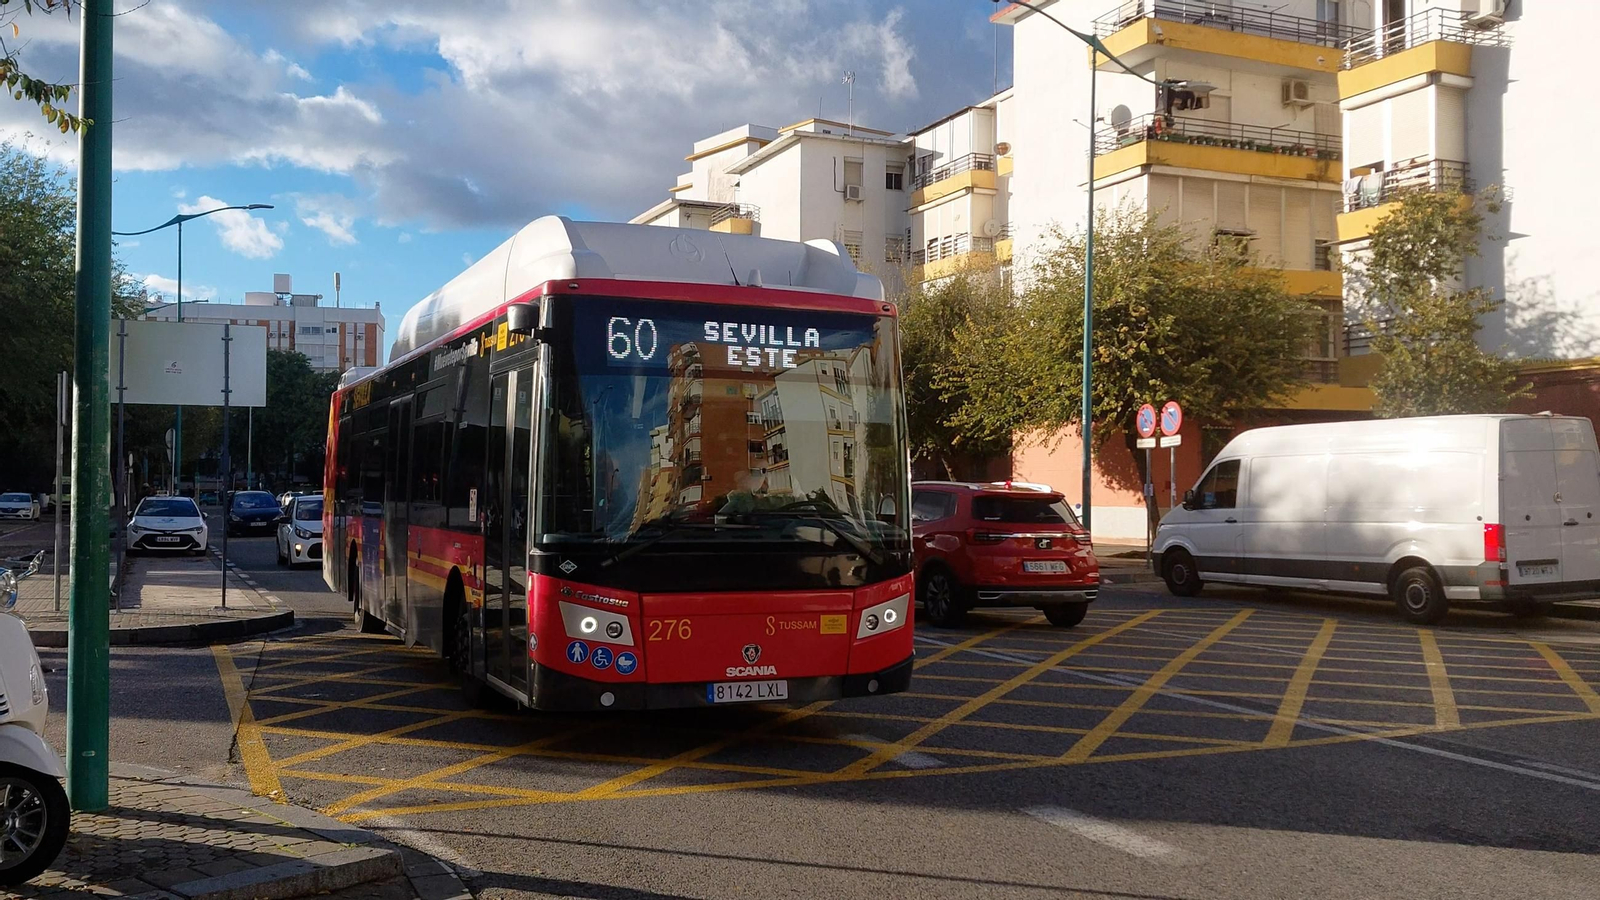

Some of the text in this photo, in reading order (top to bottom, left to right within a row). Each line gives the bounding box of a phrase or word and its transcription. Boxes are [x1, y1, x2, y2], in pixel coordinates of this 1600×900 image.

[607, 316, 657, 360] 60
[703, 320, 820, 348] SEVILLA
[727, 345, 798, 369] ESTE
[648, 618, 693, 641] 276
[778, 620, 818, 630] TUSSAM
[725, 665, 778, 678] SCANIA
[716, 683, 785, 700] 8142 LXL
